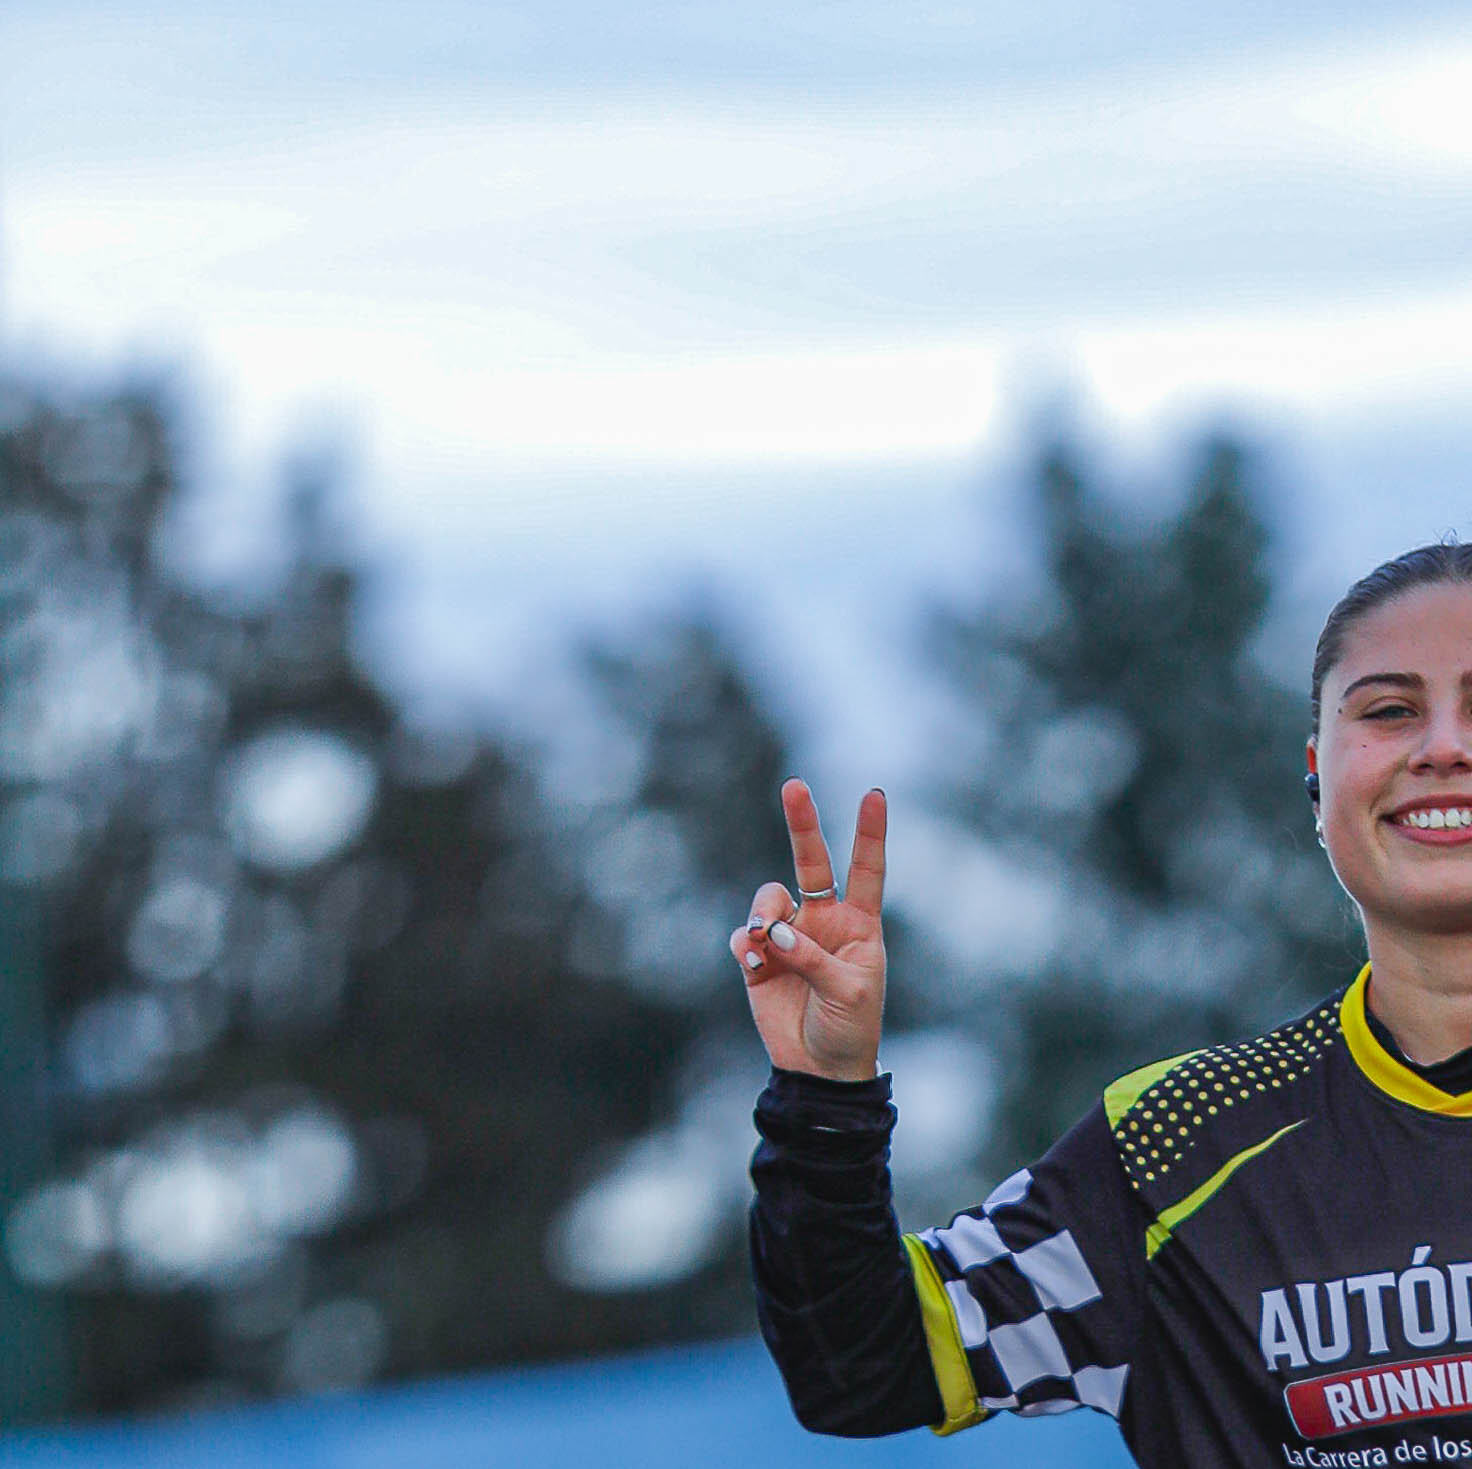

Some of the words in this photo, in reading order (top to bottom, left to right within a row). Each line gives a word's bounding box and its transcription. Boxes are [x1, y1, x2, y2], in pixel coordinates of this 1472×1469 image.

[1282, 1442, 1305, 1468] La
[1306, 1446, 1389, 1469] Carrera
[1394, 1439, 1427, 1463] de
[1433, 1435, 1472, 1460] los
